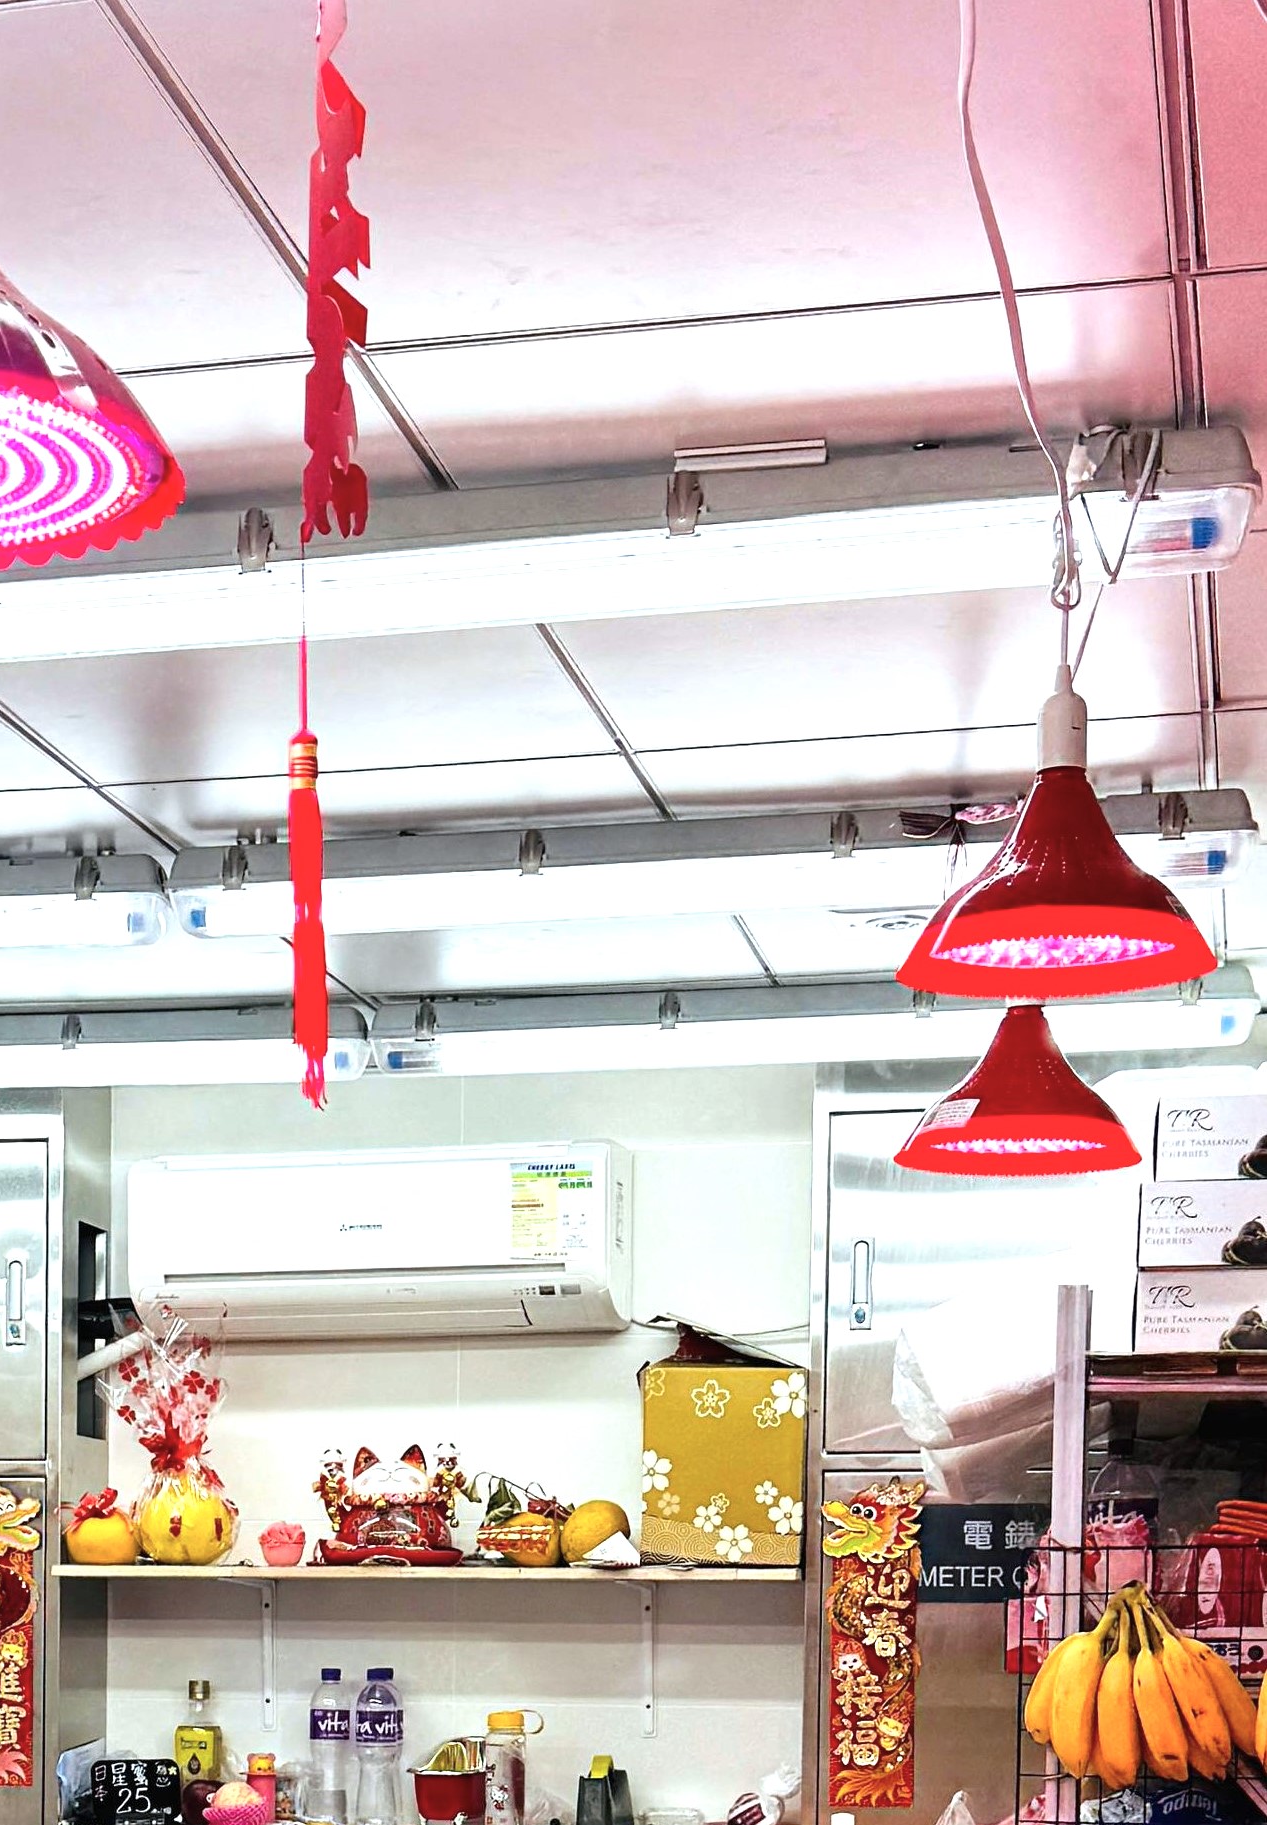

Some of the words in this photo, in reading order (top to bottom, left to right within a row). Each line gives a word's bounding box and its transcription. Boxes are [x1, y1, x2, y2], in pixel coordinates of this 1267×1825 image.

[918, 1565, 1005, 1588] METER
[832, 1564, 912, 1767] 迎春接福
[116, 1787, 152, 1814] 25
